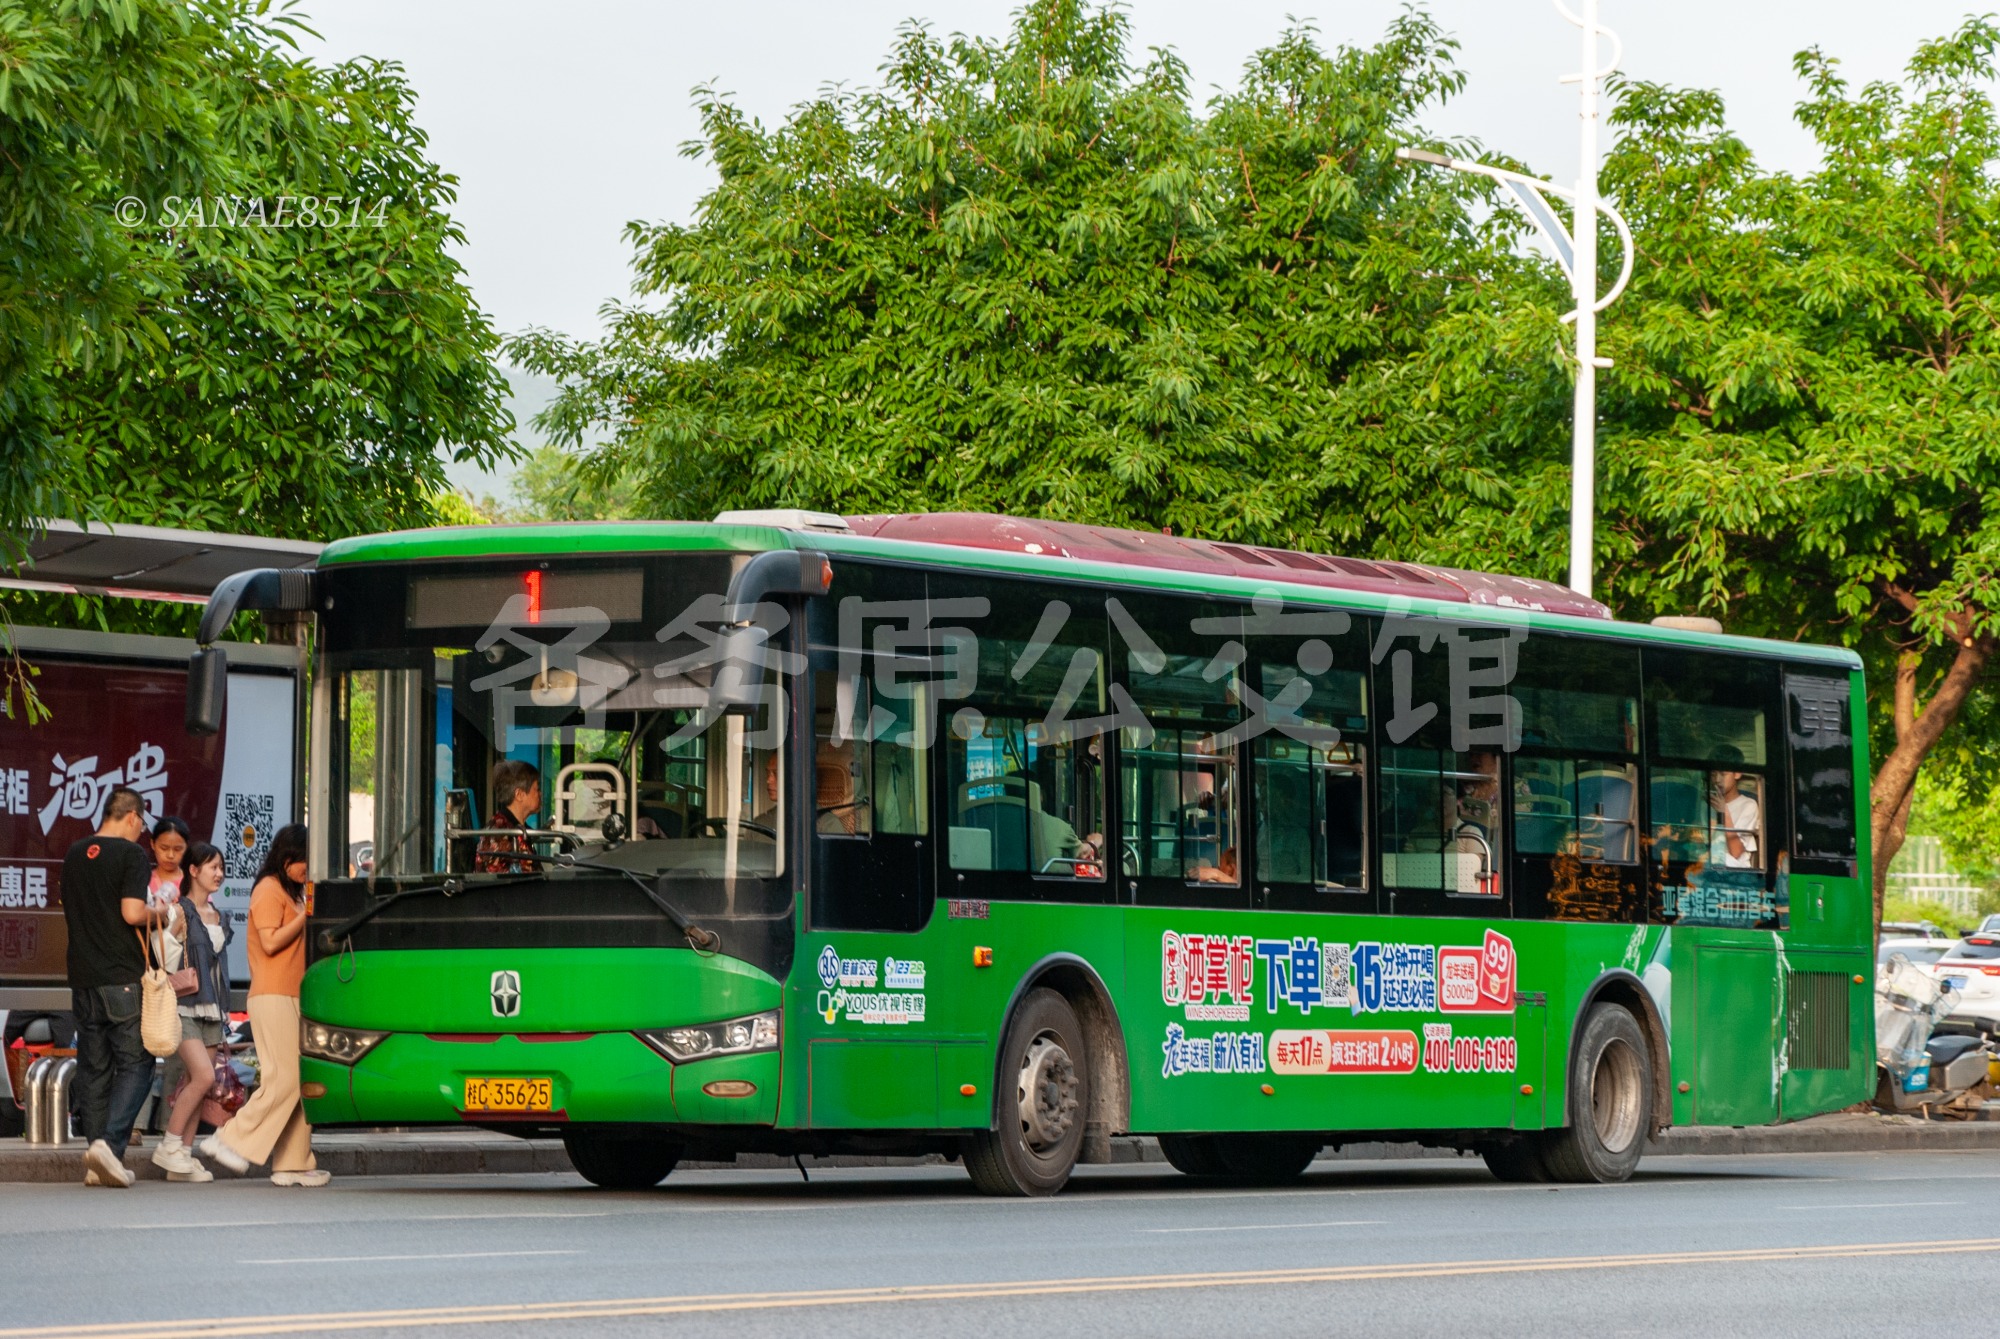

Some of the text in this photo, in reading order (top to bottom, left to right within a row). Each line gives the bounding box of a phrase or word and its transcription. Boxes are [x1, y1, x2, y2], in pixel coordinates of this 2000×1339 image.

[525, 571, 541, 623] 1
[0, 768, 29, 815] 柜
[1183, 936, 1252, 1003] 酒掌柜
[1257, 940, 1322, 1012] 下单
[1352, 944, 1382, 1011] 15
[1382, 947, 1434, 977] 分钟开喝
[1382, 979, 1435, 1009] 延迟必赔
[1214, 1035, 1265, 1071] 新人有礼
[1277, 1036, 1324, 1067] 每天17点
[1425, 1038, 1515, 1071] 400-006-6199
